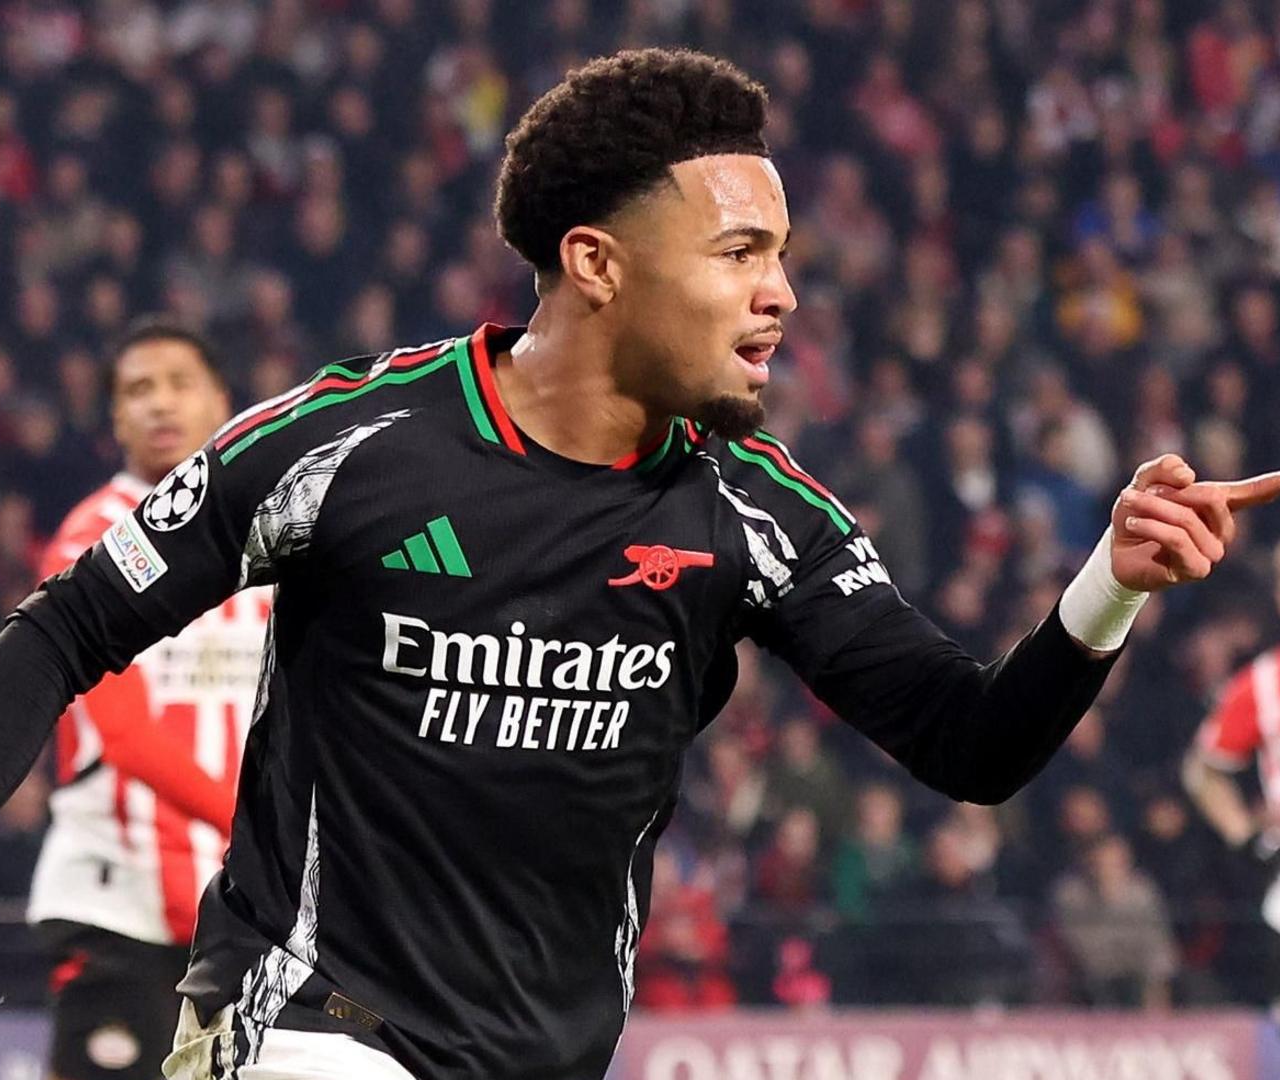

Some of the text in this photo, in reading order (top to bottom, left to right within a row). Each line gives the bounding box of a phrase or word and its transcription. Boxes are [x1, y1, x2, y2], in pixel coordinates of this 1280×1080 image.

[382, 612, 675, 692] Emirates
[418, 688, 630, 751] FLY BETTER
